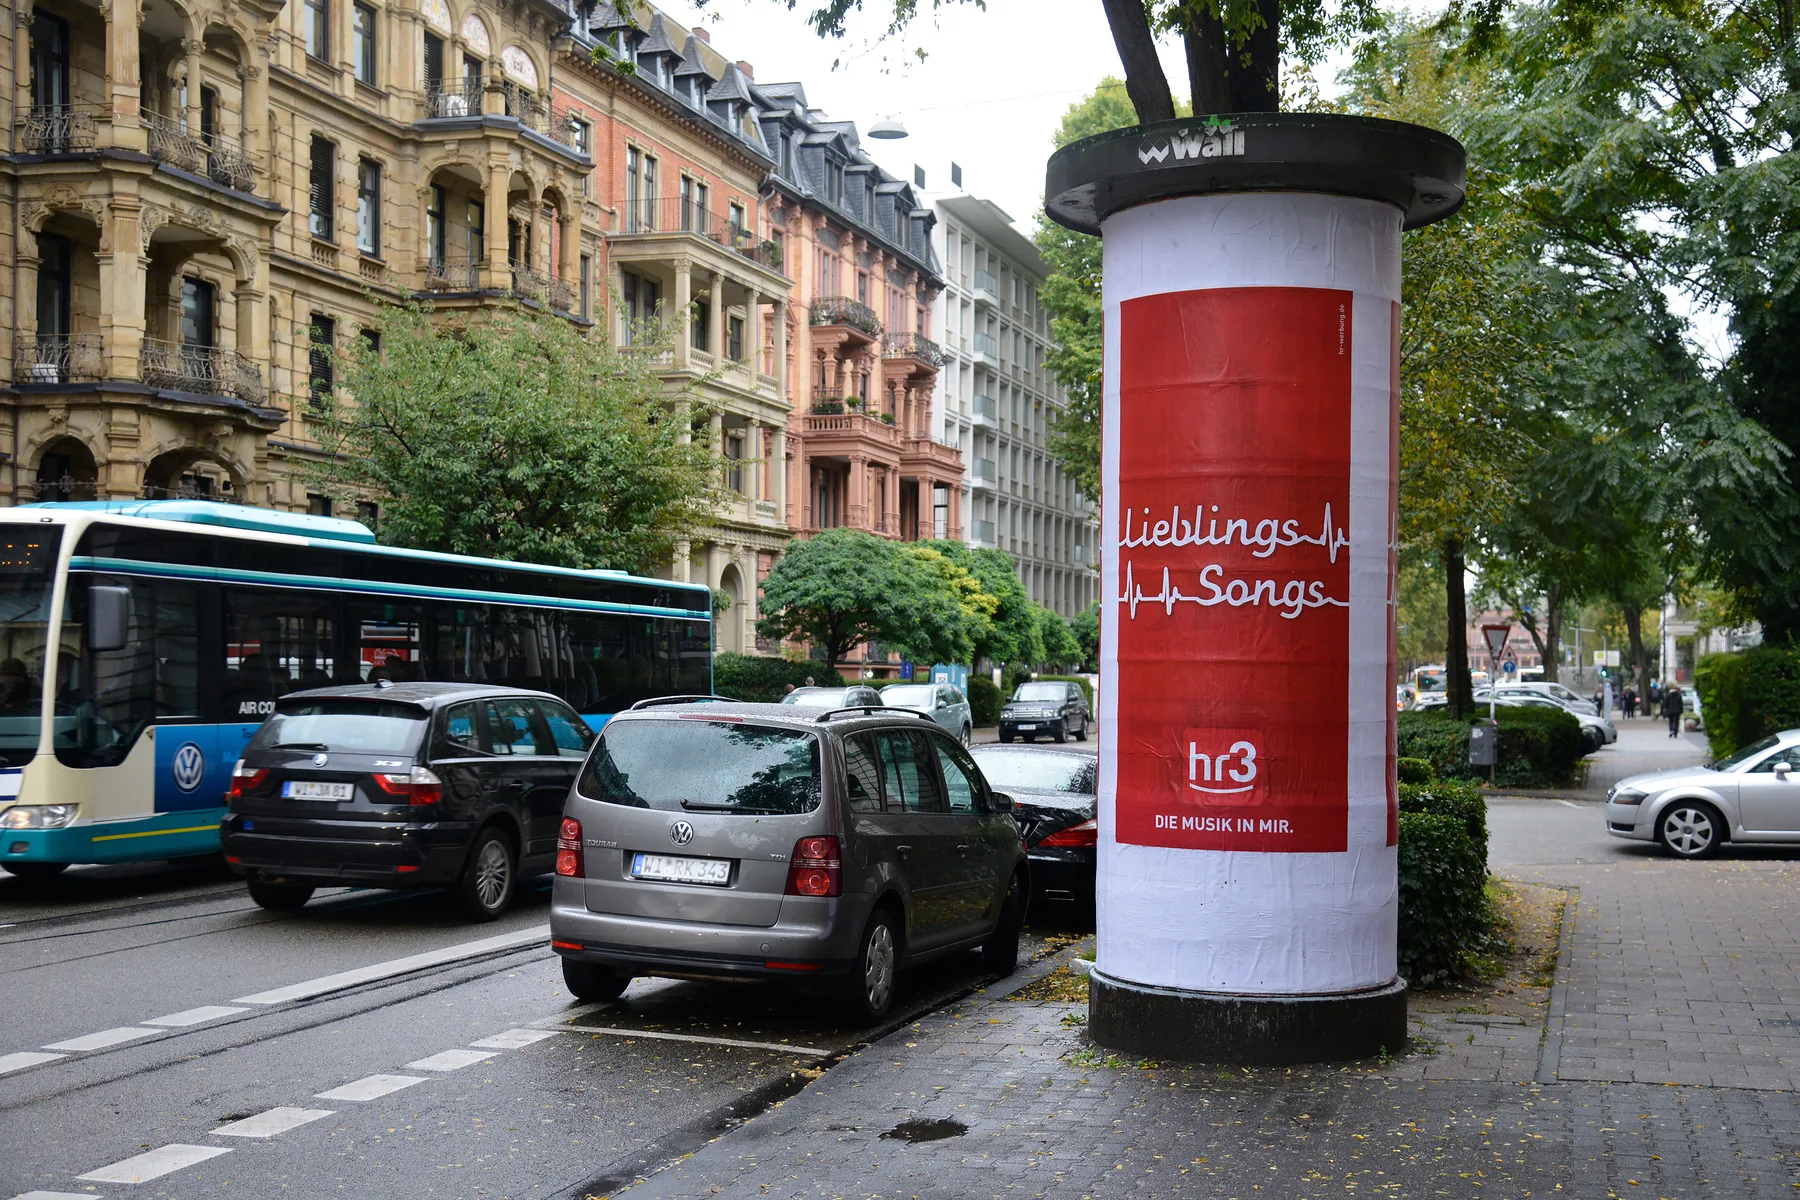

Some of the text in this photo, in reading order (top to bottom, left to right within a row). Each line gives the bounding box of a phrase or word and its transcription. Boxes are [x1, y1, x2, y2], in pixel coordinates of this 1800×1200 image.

[1170, 130, 1245, 160] Wall
[1338, 303, 1346, 355] hr-werbung.de
[1198, 563, 1326, 619] Songs
[238, 701, 257, 714] AIR
[373, 759, 403, 767] X3
[1189, 740, 1257, 783] hr3
[295, 783, 346, 797] WI JA 81
[1155, 814, 1294, 834] DIE MUSIK IN MIR.
[586, 839, 618, 848] TOURAN
[644, 857, 662, 873] WI
[674, 860, 695, 877] RK
[697, 862, 728, 879] 343
